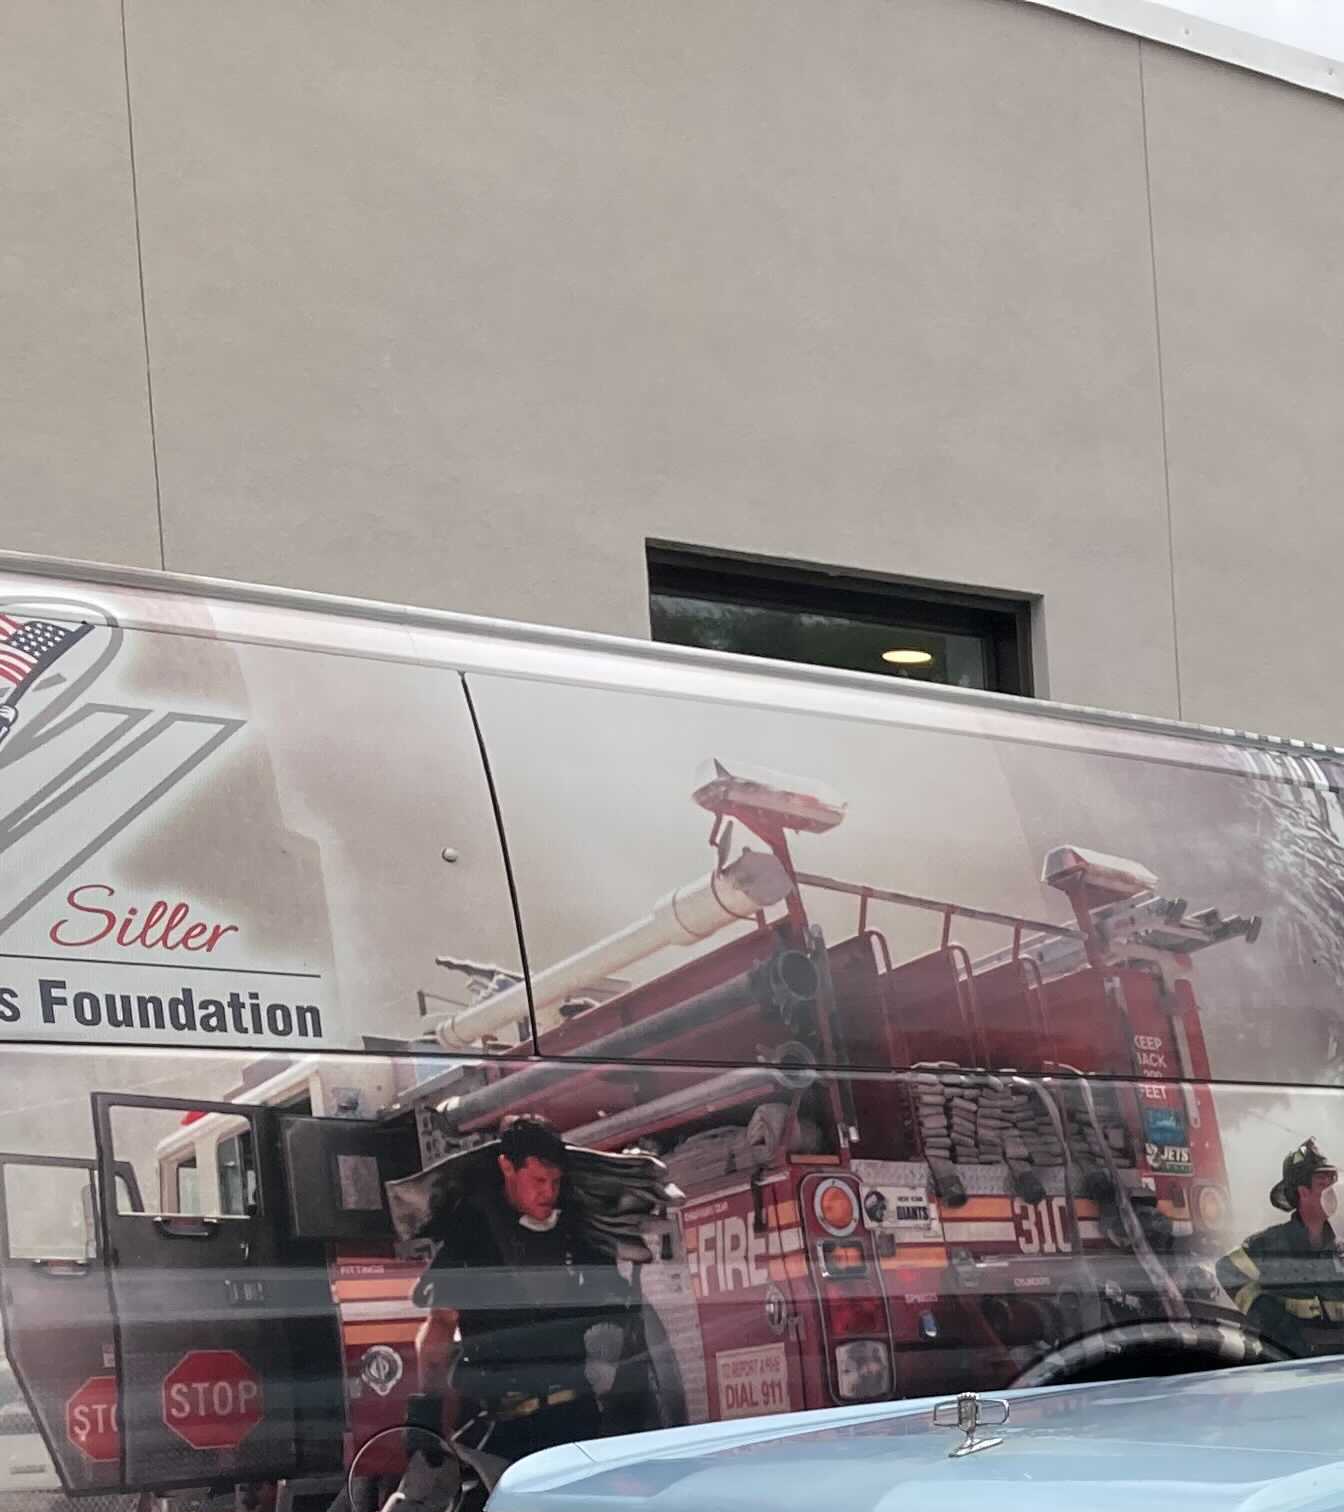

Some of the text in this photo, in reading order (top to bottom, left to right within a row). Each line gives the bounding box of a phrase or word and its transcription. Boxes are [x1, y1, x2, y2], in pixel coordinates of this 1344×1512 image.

[49, 884, 240, 953] Siller
[38, 979, 323, 1039] Foundation
[698, 1211, 769, 1297] FIRE
[170, 1381, 258, 1418] STOP
[726, 1380, 784, 1410] DIAL 911
